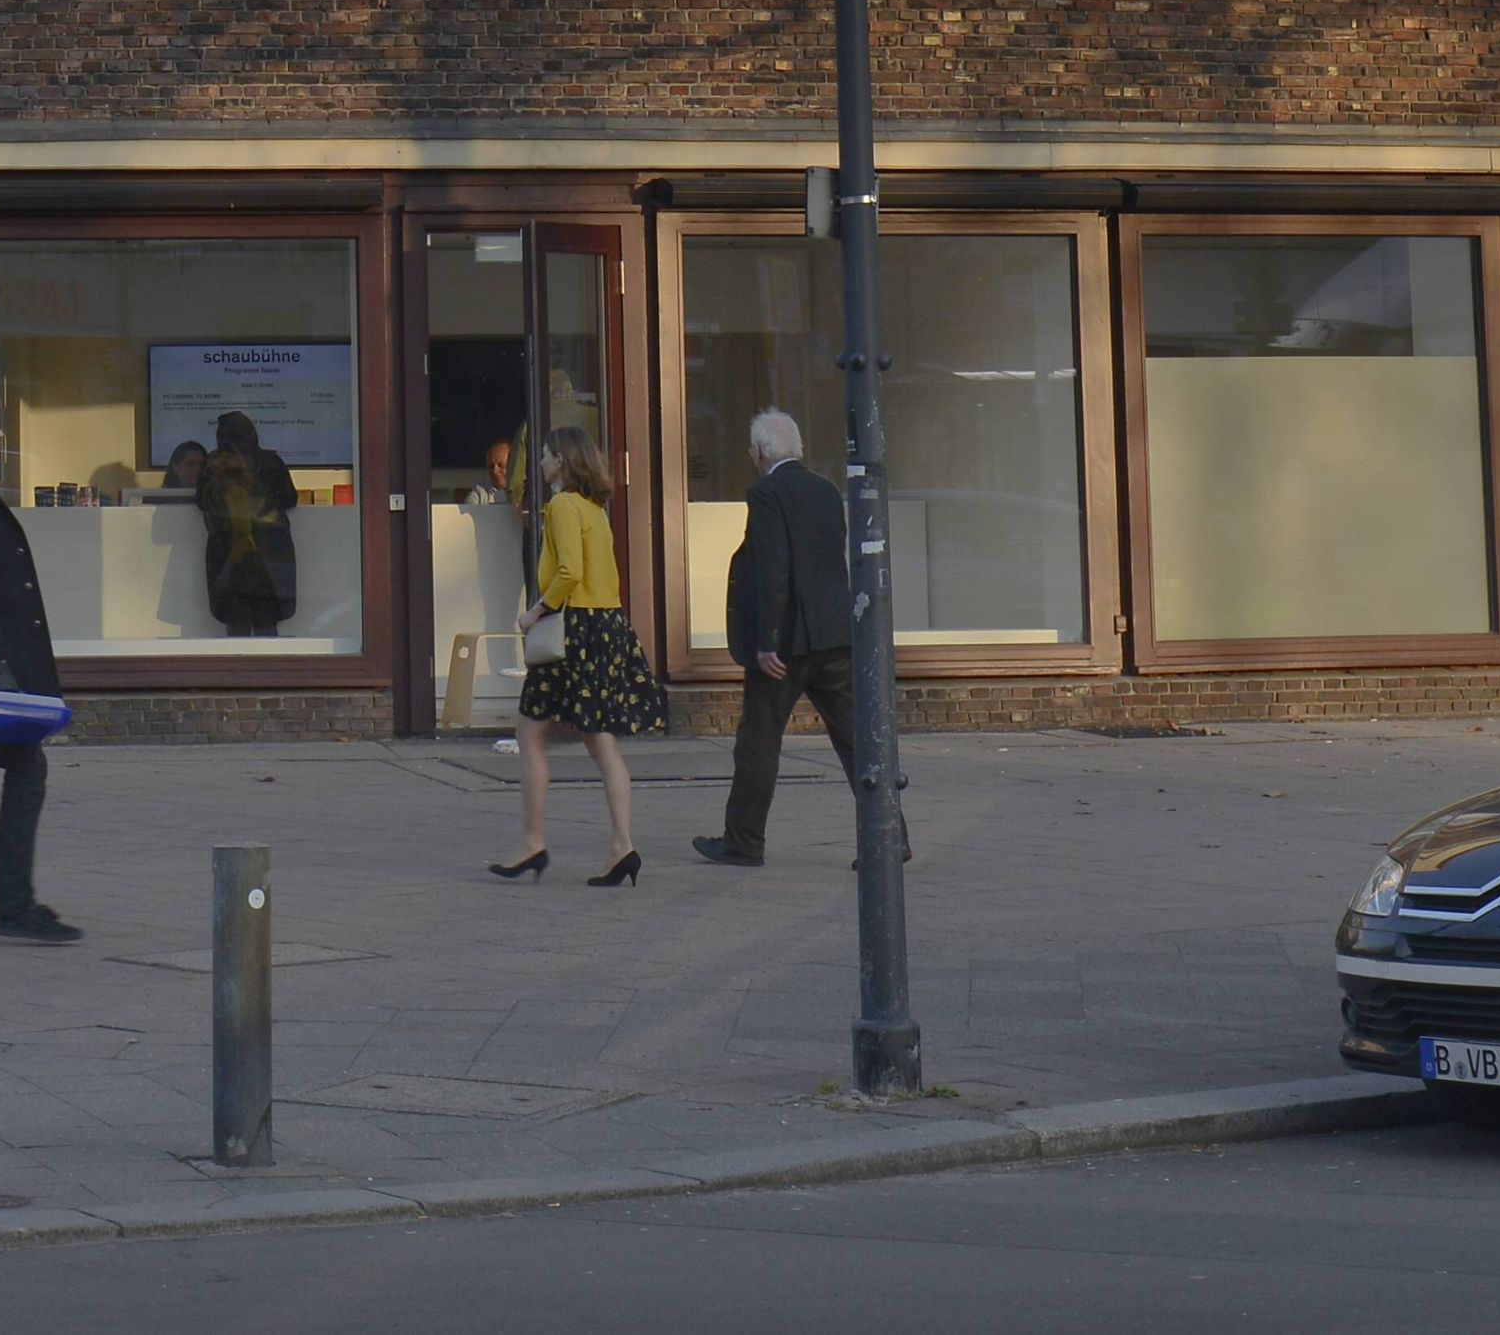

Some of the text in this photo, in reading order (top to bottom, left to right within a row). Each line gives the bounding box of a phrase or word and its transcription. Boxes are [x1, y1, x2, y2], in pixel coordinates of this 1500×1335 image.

[203, 348, 302, 364] schaubühne
[1435, 1045, 1451, 1075] B
[1467, 1048, 1498, 1079] VB
